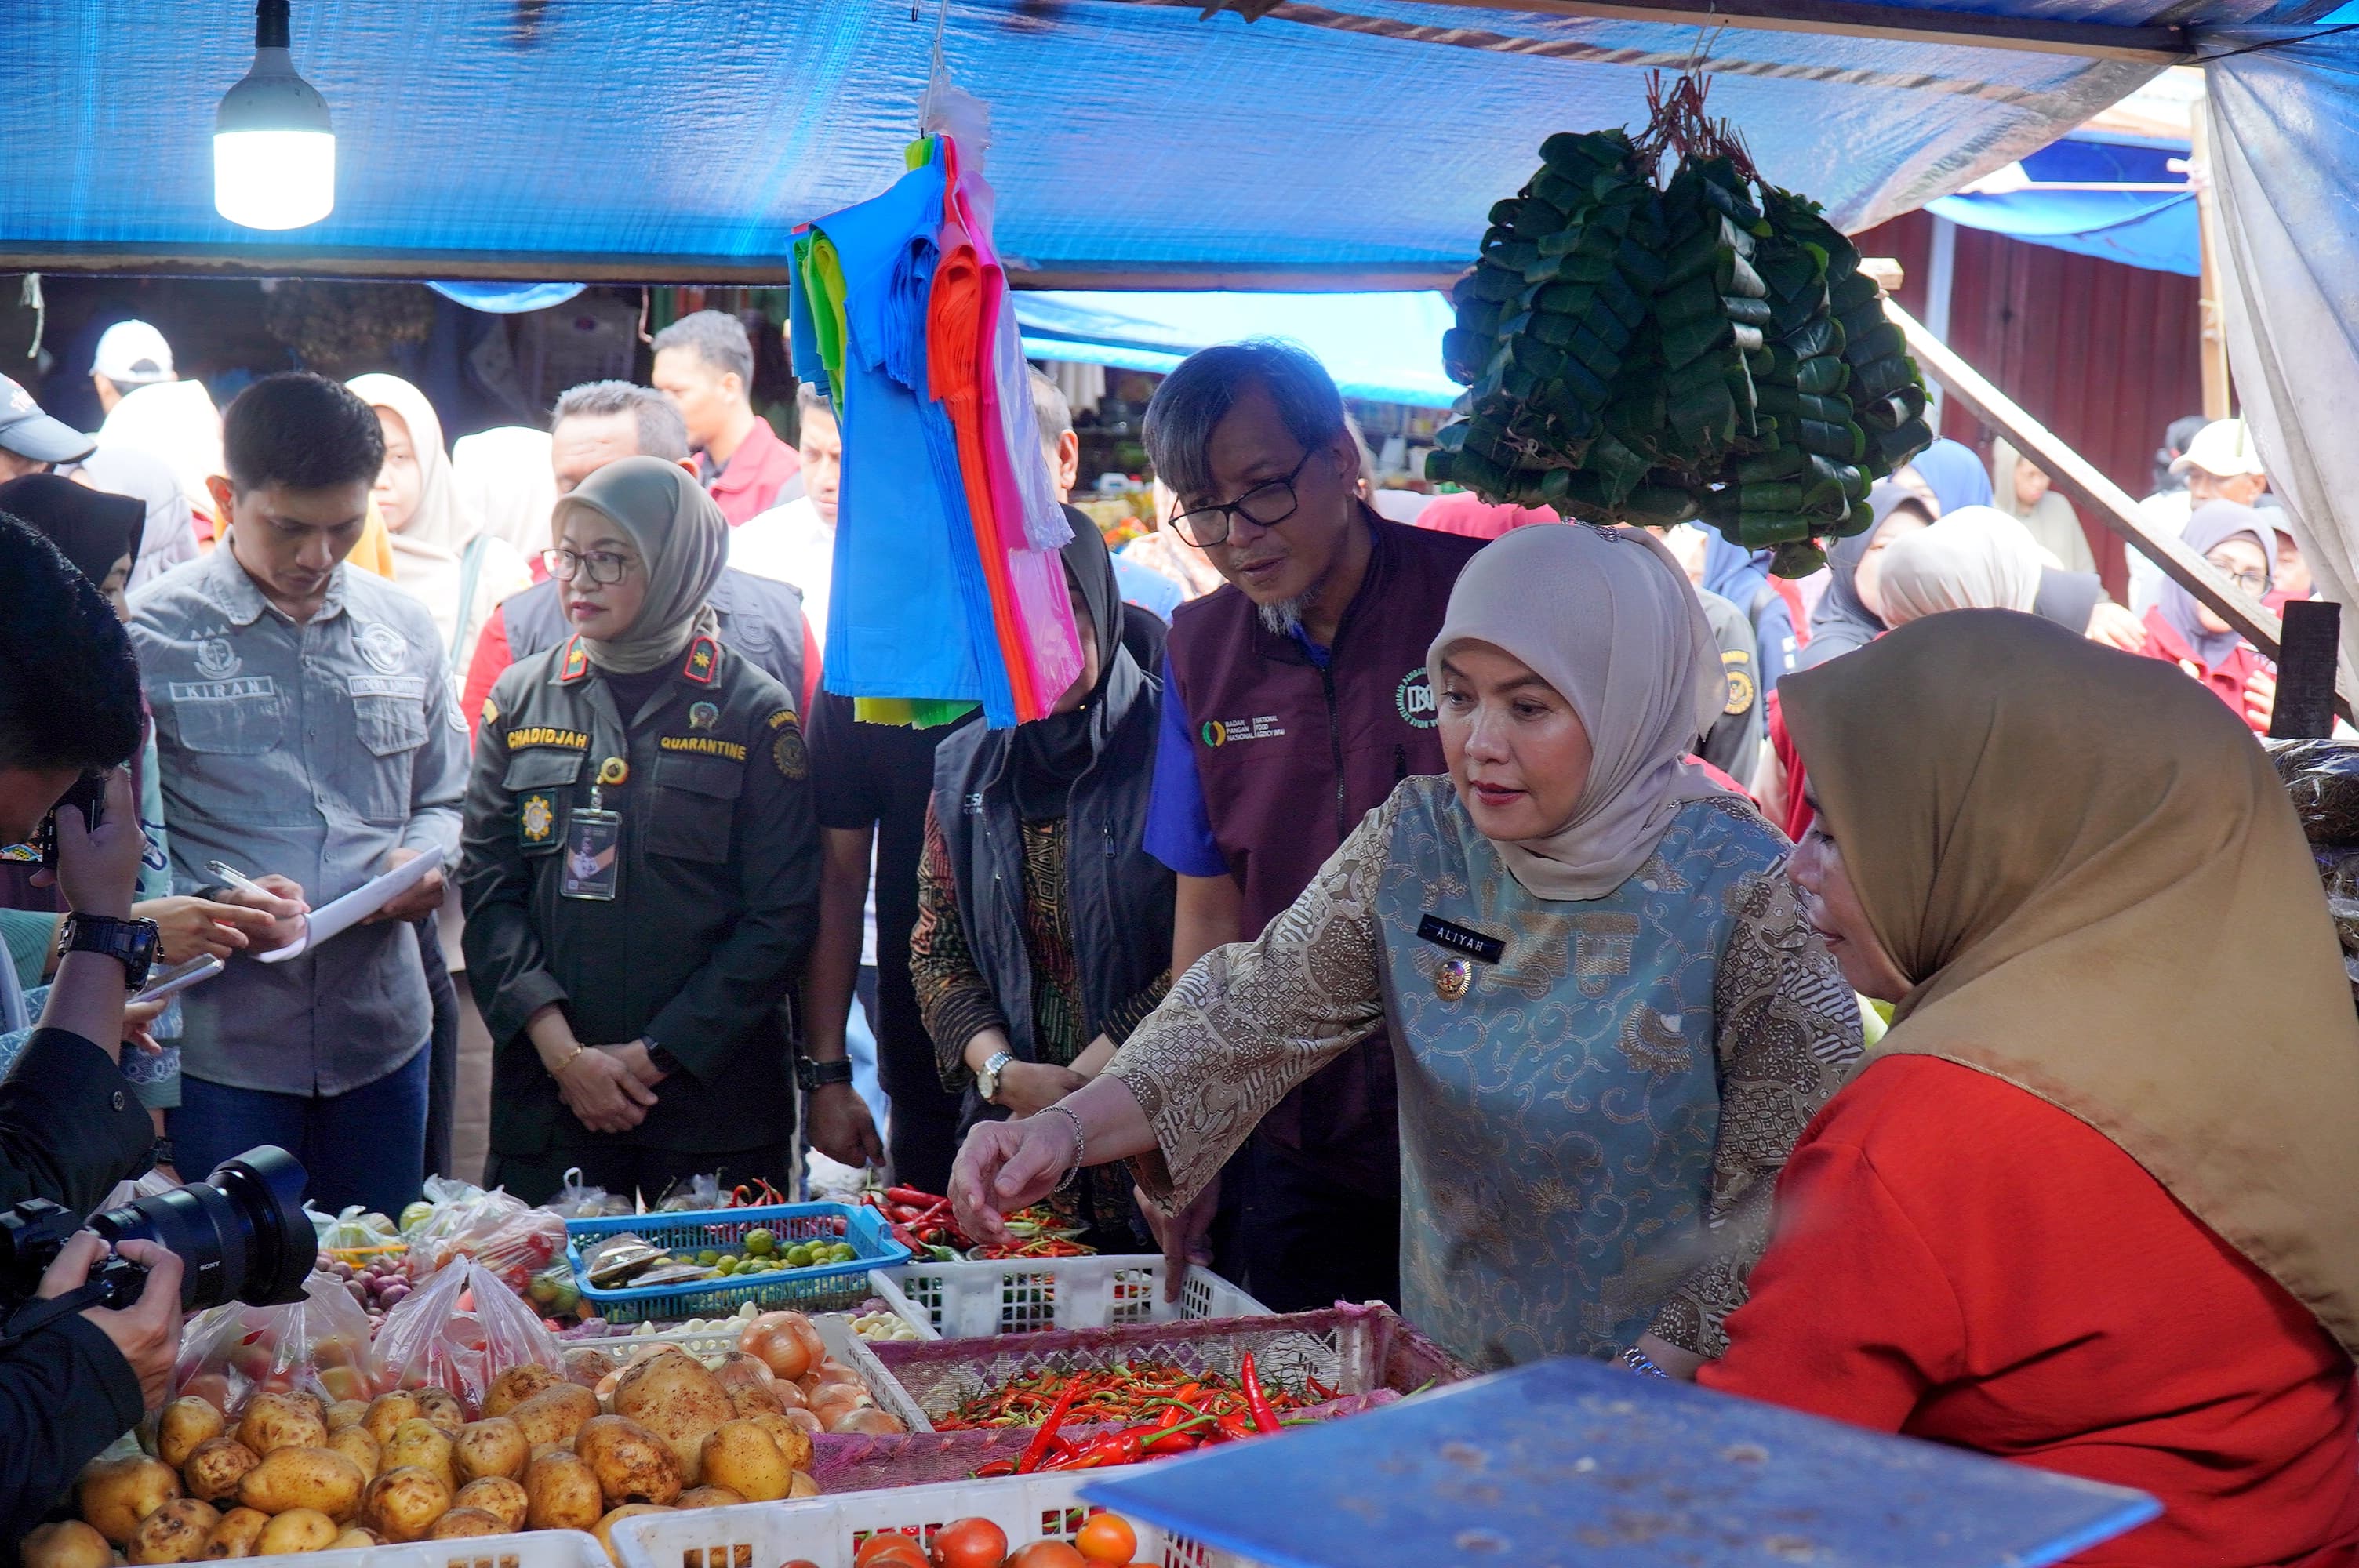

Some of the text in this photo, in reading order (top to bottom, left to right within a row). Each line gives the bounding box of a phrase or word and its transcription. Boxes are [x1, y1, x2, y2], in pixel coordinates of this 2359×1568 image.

[186, 680, 260, 698] KIRAN
[507, 728, 588, 749] CHADIDJAH
[1226, 726, 1249, 735] PANGAN
[1227, 732, 1255, 742] NASIONAL
[660, 736, 747, 760] QUARANTINE
[1436, 927, 1484, 953] ALIYAH
[200, 1261, 220, 1271] SONY
